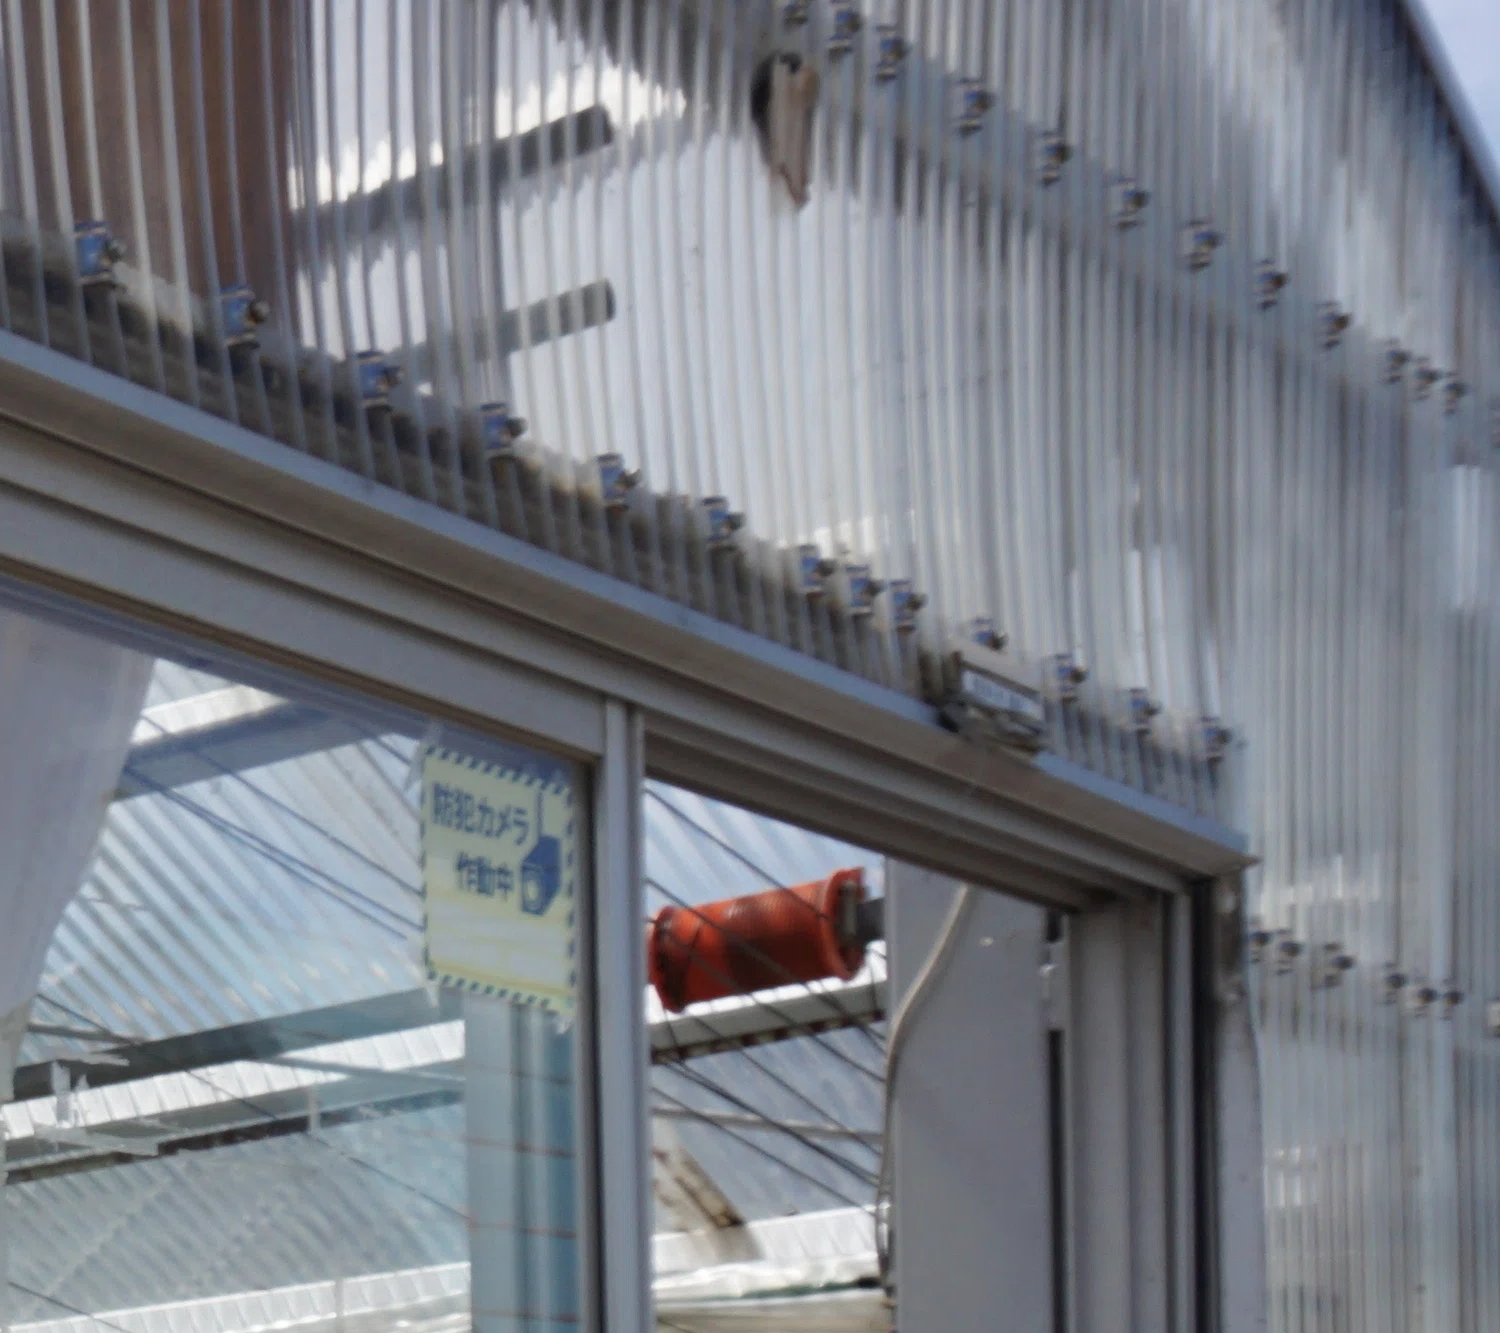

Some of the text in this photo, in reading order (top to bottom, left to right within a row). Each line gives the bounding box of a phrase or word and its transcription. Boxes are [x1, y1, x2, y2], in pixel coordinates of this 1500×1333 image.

[432, 781, 530, 847] 防犯カメラ
[456, 850, 515, 902] 作動中
